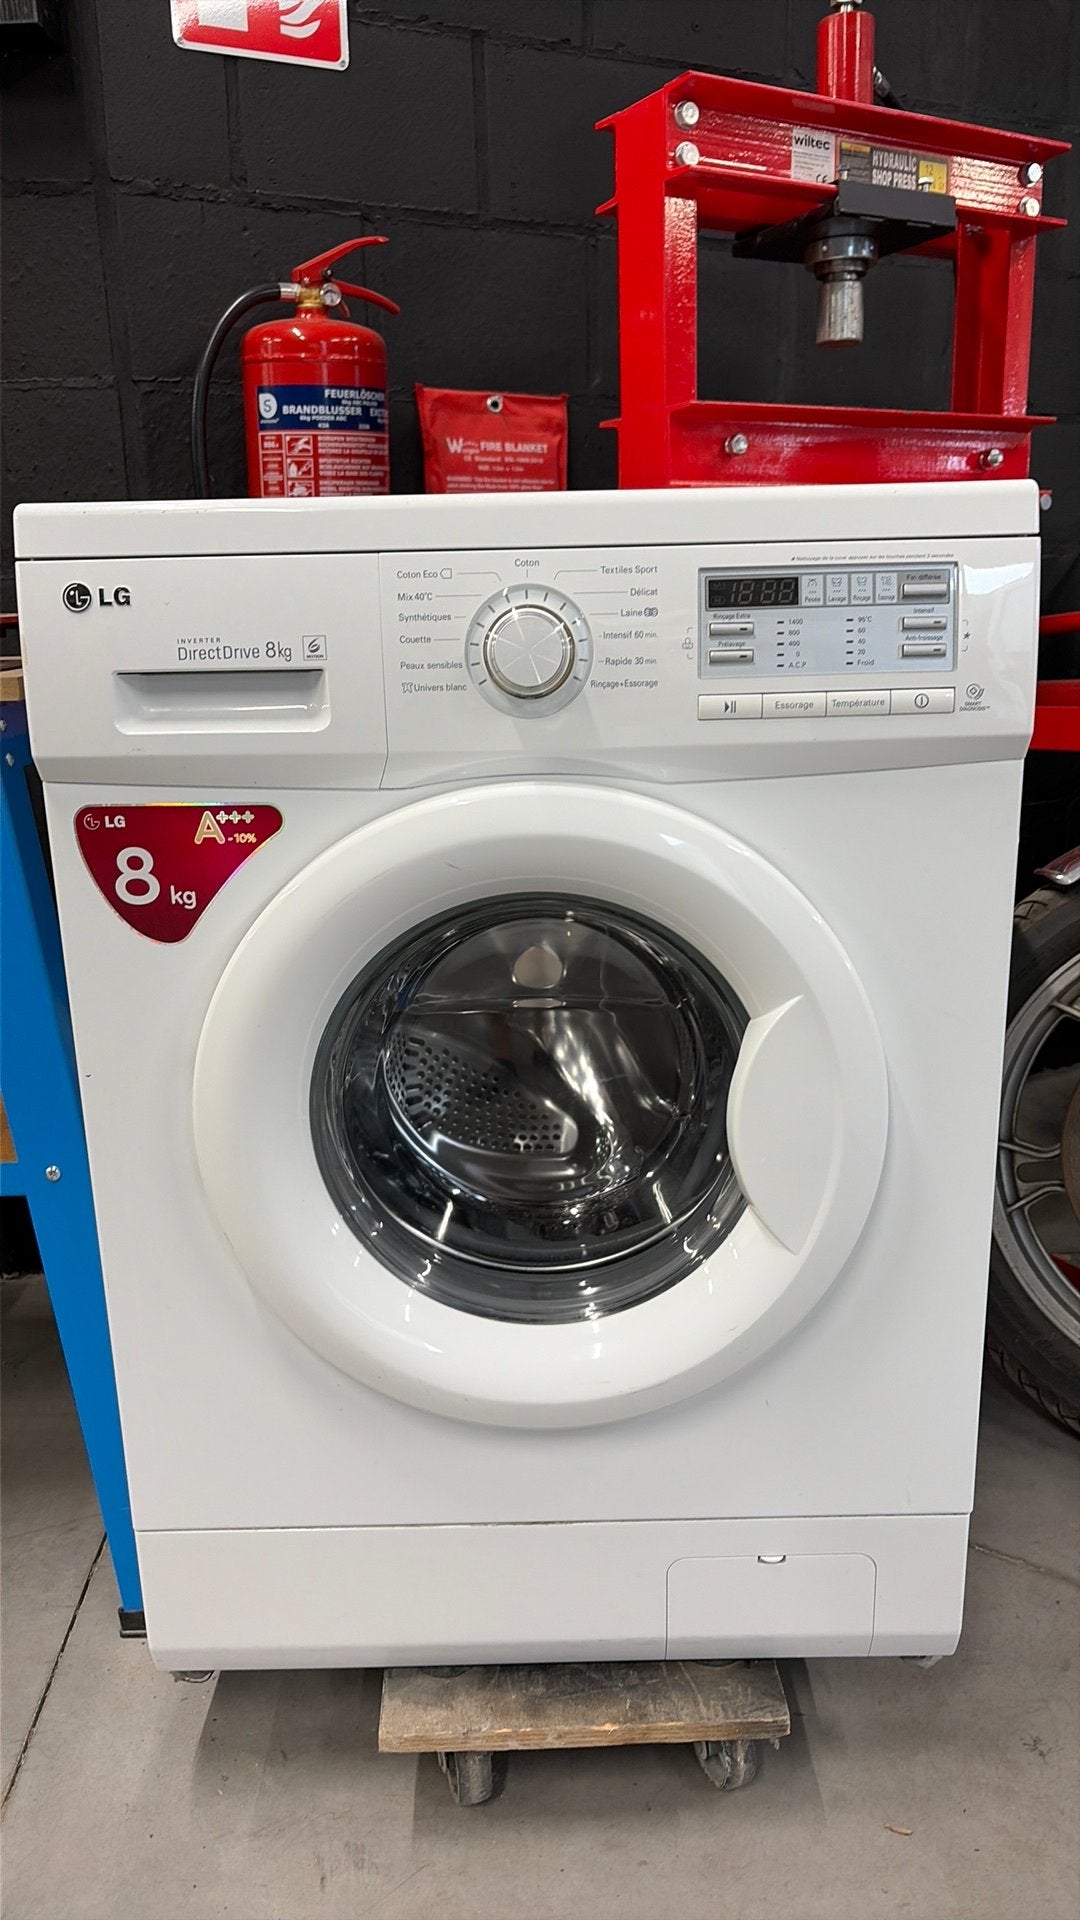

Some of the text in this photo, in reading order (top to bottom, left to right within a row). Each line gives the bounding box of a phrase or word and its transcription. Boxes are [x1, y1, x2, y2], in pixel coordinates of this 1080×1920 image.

[794, 134, 830, 151] wiltec
[872, 150, 917, 173] HYDRAULIC
[872, 168, 893, 187] SHOP
[893, 171, 917, 191] PRESS
[282, 405, 362, 416] BRANDBLUSSER
[480, 441, 503, 452] FIRE
[504, 442, 548, 454] BLANKET
[514, 558, 540, 567] Coton
[396, 570, 438, 580] Coton Eco
[600, 565, 658, 576] Textiles Sport
[98, 586, 131, 607] LG
[397, 592, 413, 601] Mix
[630, 587, 658, 597] Délicat
[398, 612, 452, 624] Synthétiques
[620, 608, 643, 617] Laine
[736, 612, 751, 620] Extra
[399, 634, 432, 645] Couette
[603, 630, 632, 640] Intensif
[634, 630, 644, 640] 60
[177, 637, 222, 645] INVERTER
[400, 660, 463, 670] Peaux sensibles
[605, 656, 632, 668] Rapide
[634, 656, 644, 666] 30
[857, 658, 875, 666] Froid
[414, 682, 468, 692] Univers blanc
[590, 679, 659, 690] Rinçage+Essorage
[774, 700, 814, 711] Essorage
[831, 698, 885, 709] Température
[104, 815, 126, 828] LG
[227, 832, 257, 844] -10%
[115, 846, 197, 910] 8 kg
